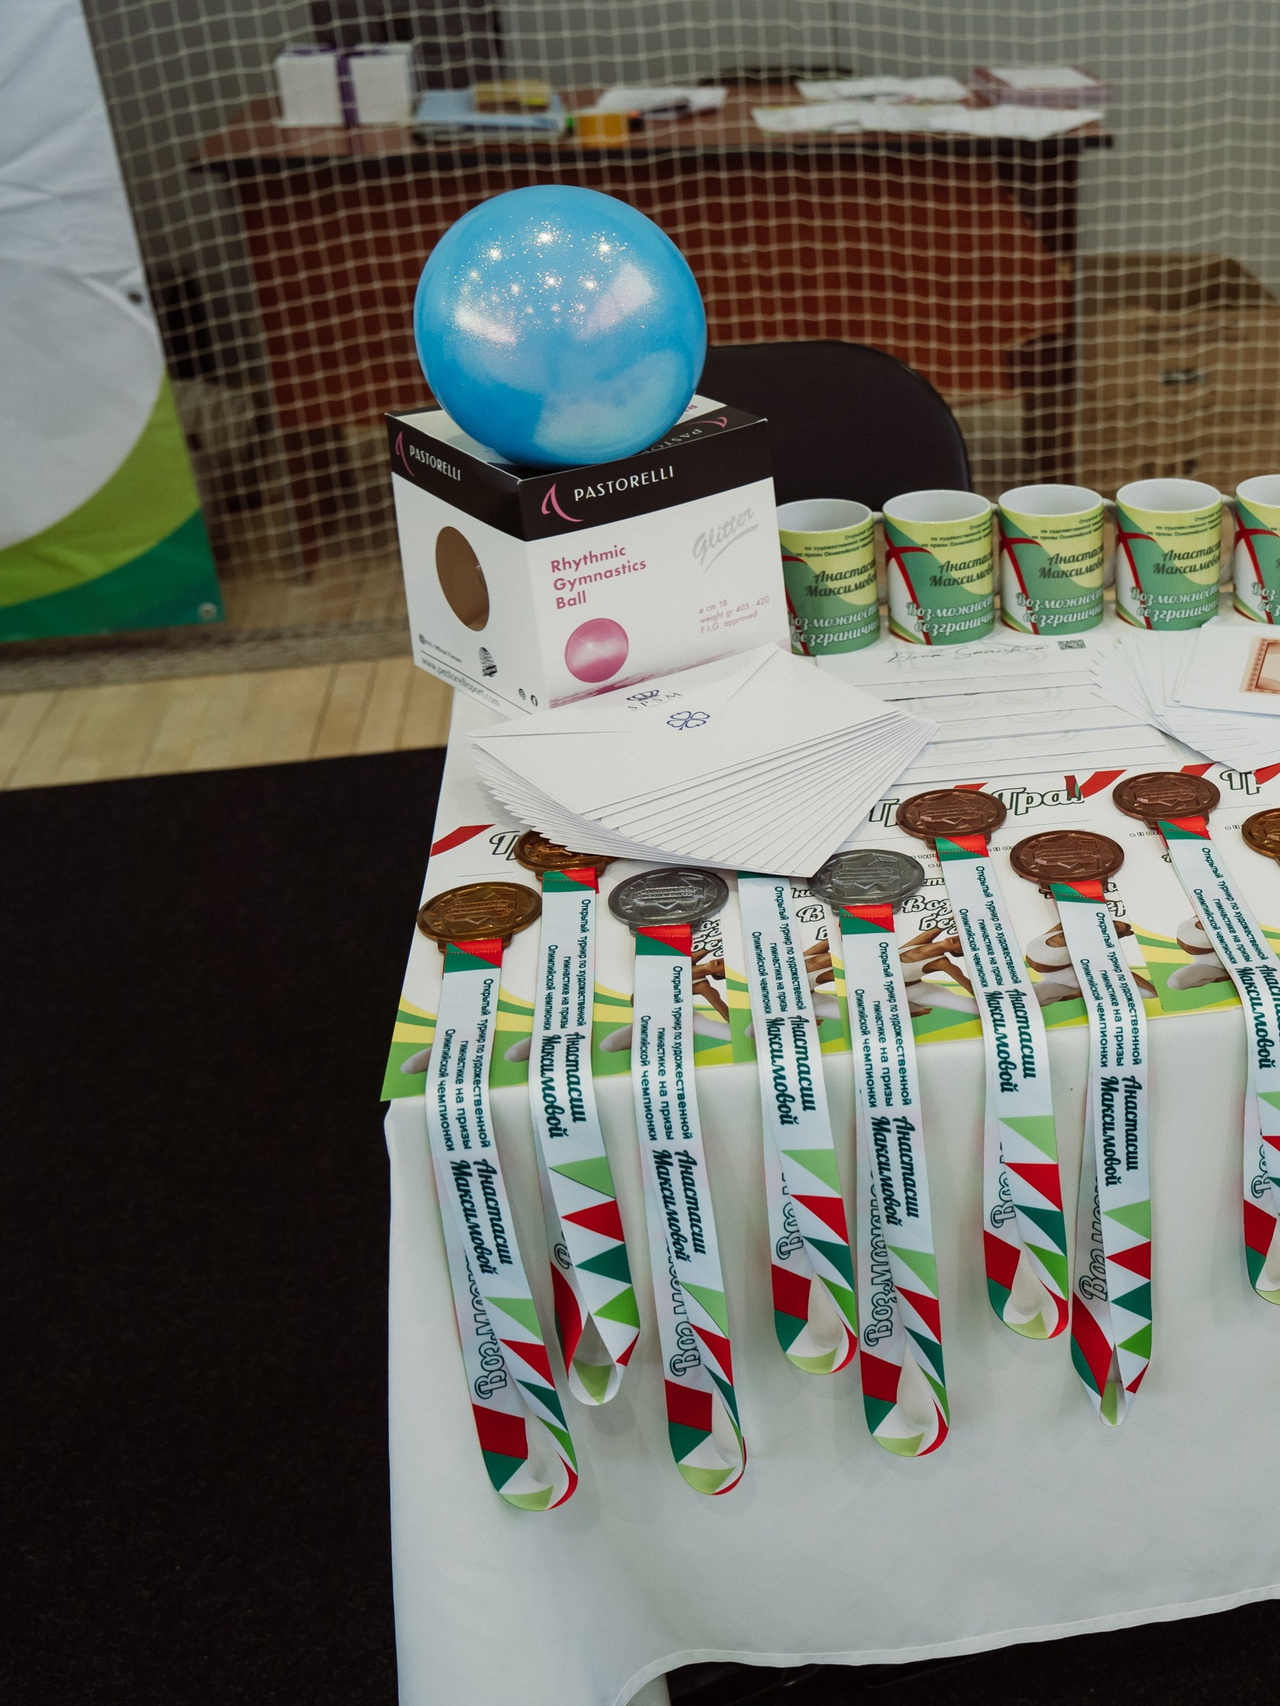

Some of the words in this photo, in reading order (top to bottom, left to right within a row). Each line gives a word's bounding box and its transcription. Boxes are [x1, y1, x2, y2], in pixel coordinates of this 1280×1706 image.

[409, 445, 461, 482] PASTORELLI
[574, 465, 674, 502] PASTORELLI
[551, 545, 626, 572] Rhythmic
[692, 508, 755, 566] Glitter
[554, 558, 646, 592] Gymnastics
[556, 591, 586, 609] Ball
[700, 610, 724, 624] weight
[726, 609, 733, 618] gr
[736, 601, 750, 612] 405
[756, 595, 769, 607] 420
[706, 603, 716, 611] cm
[719, 599, 728, 608] 18
[701, 622, 720, 634] F.I.G.
[724, 610, 758, 628] approved
[1095, 912, 1115, 948] Открытый
[878, 942, 894, 978] Открытый
[1104, 952, 1122, 973] турнир
[481, 979, 493, 1015] Открытый
[672, 966, 683, 1003] Открытый
[884, 981, 897, 1002] турнир
[1100, 970, 1118, 1006] гимнастике
[672, 1007, 682, 1030] турнир
[855, 989, 870, 1036] Олимпийской
[872, 1000, 888, 1043] гимнастике
[890, 1004, 897, 1012] по
[1080, 958, 1102, 1000] Олимпийской
[1095, 1002, 1110, 1068] чемпионки
[1114, 1009, 1123, 1022] на
[1117, 982, 1142, 1065] художественной
[1235, 967, 1276, 1069] Максимовой
[476, 1019, 489, 1043] турнир
[476, 1045, 486, 1053] по
[640, 1016, 651, 1066] Олимпийской
[657, 1028, 668, 1076] гимнастике
[674, 1032, 682, 1040] по
[984, 991, 1019, 1093] Максимовой
[1005, 989, 1037, 1079] Анастасии
[1113, 1026, 1125, 1066] призы
[438, 1029, 455, 1078] Олимпийской
[455, 1040, 470, 1084] гимнастике
[766, 1017, 799, 1125] Максимовой
[787, 1015, 816, 1111] Анастасии
[862, 1039, 878, 1108] чемпионки
[880, 1048, 889, 1062] на
[888, 1014, 912, 1106] художественной
[455, 1088, 465, 1103] на
[540, 1035, 569, 1139] Максимовой
[565, 1032, 587, 1123] Анастасии
[659, 1081, 668, 1096] на
[673, 1042, 693, 1139] художественной
[880, 1067, 895, 1107] призы
[437, 1080, 455, 1151] чемпионки
[473, 1055, 490, 1147] художественной
[641, 1070, 658, 1141] чемпионки
[658, 1101, 675, 1140] призы
[455, 1108, 471, 1149] призы
[1101, 1076, 1121, 1186] Максимовой
[1122, 1076, 1142, 1171] Анастасии
[870, 1116, 903, 1226] Максимовой
[892, 1116, 920, 1218] Анастасии
[450, 1160, 498, 1274] Максимовой
[473, 1159, 513, 1265] Анастасии
[652, 1150, 691, 1262] Максимовой
[675, 1150, 707, 1255] Анастасии
